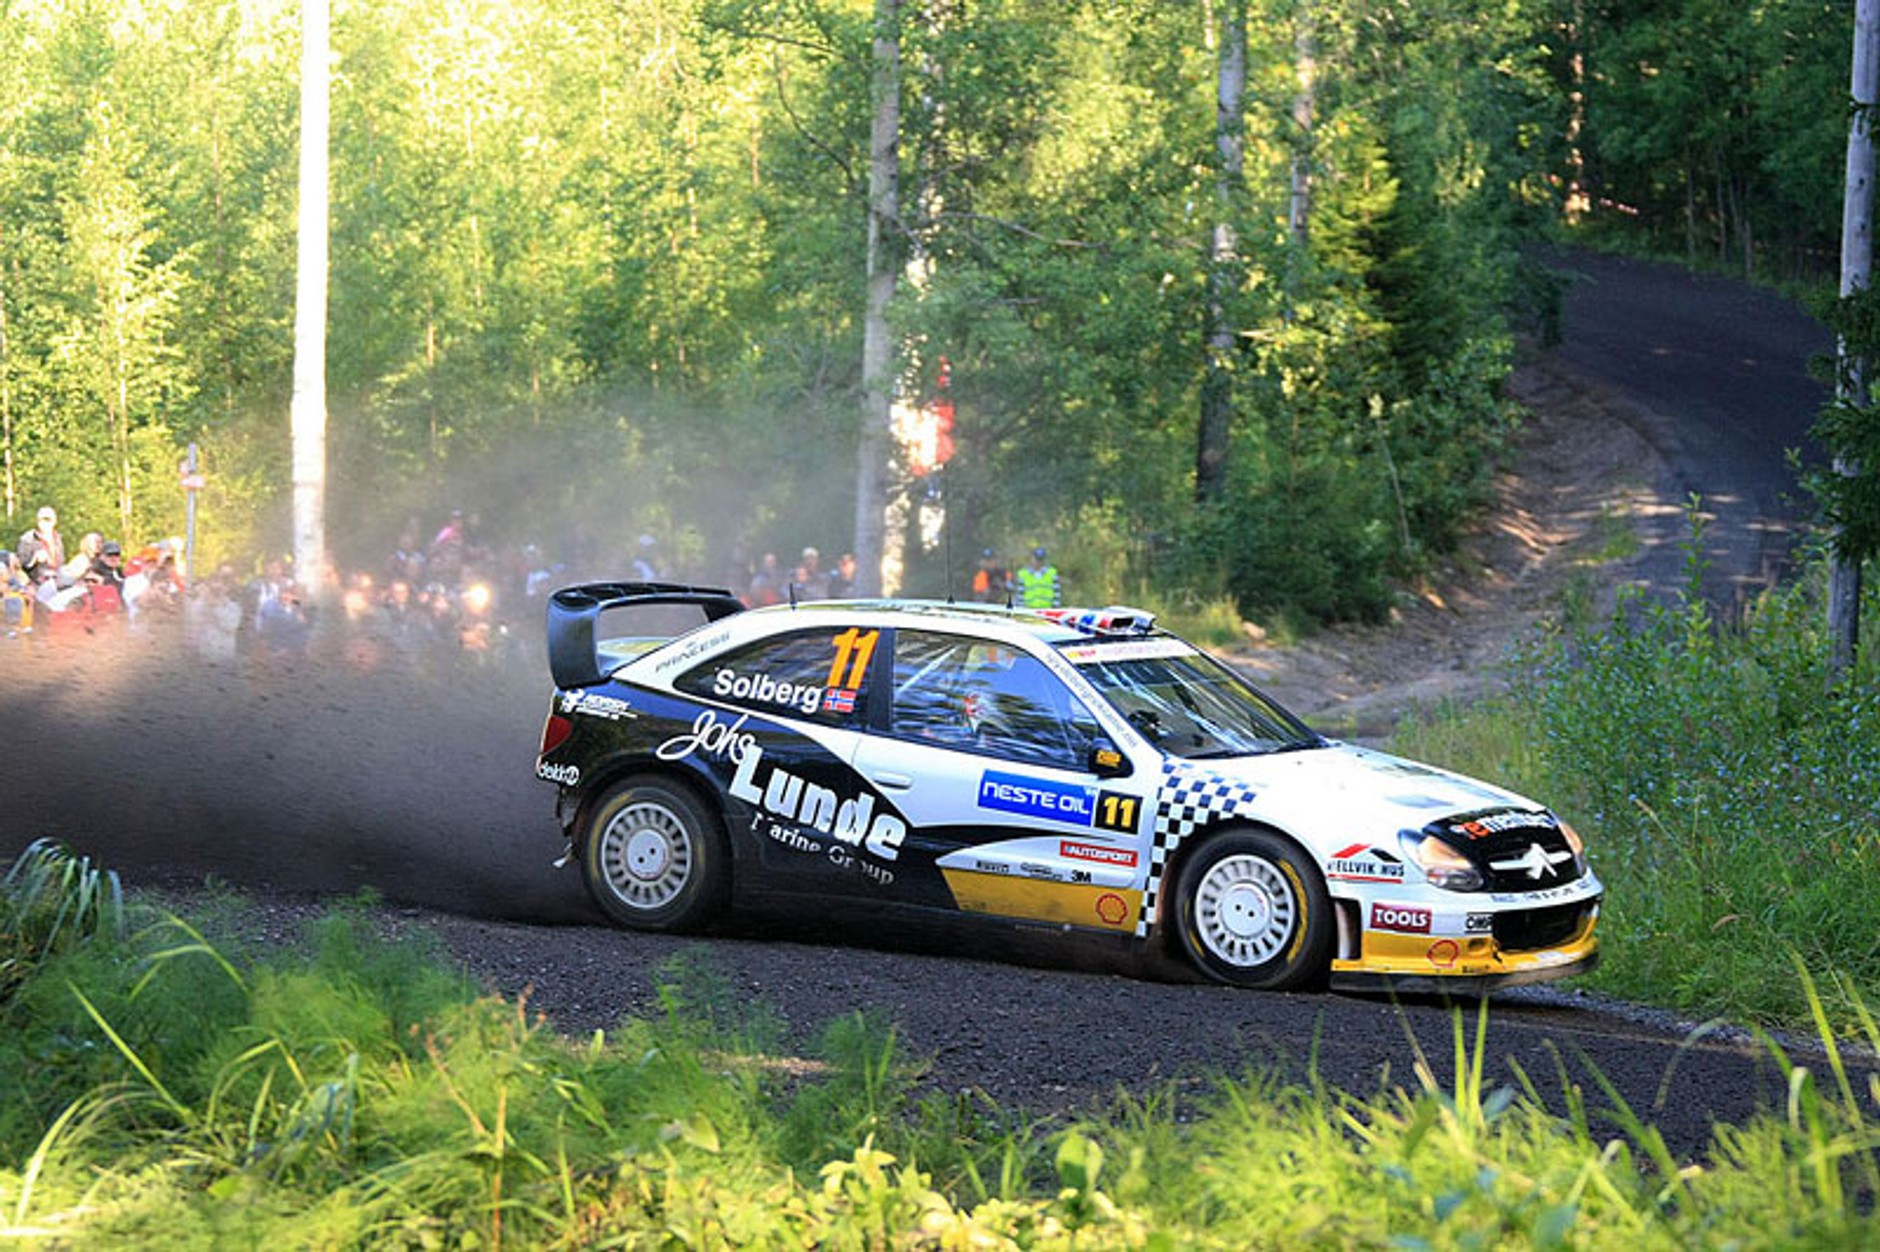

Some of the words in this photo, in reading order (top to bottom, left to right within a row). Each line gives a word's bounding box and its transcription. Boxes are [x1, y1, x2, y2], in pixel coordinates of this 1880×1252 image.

[832, 627, 879, 689] 11
[713, 669, 822, 714] Solberg
[728, 743, 907, 861] Lunde
[982, 781, 1056, 809] NESTE
[1059, 795, 1090, 815] OIL
[1104, 796, 1135, 828] 11
[1070, 869, 1092, 884] 3M
[1375, 908, 1428, 927] TOOLS
